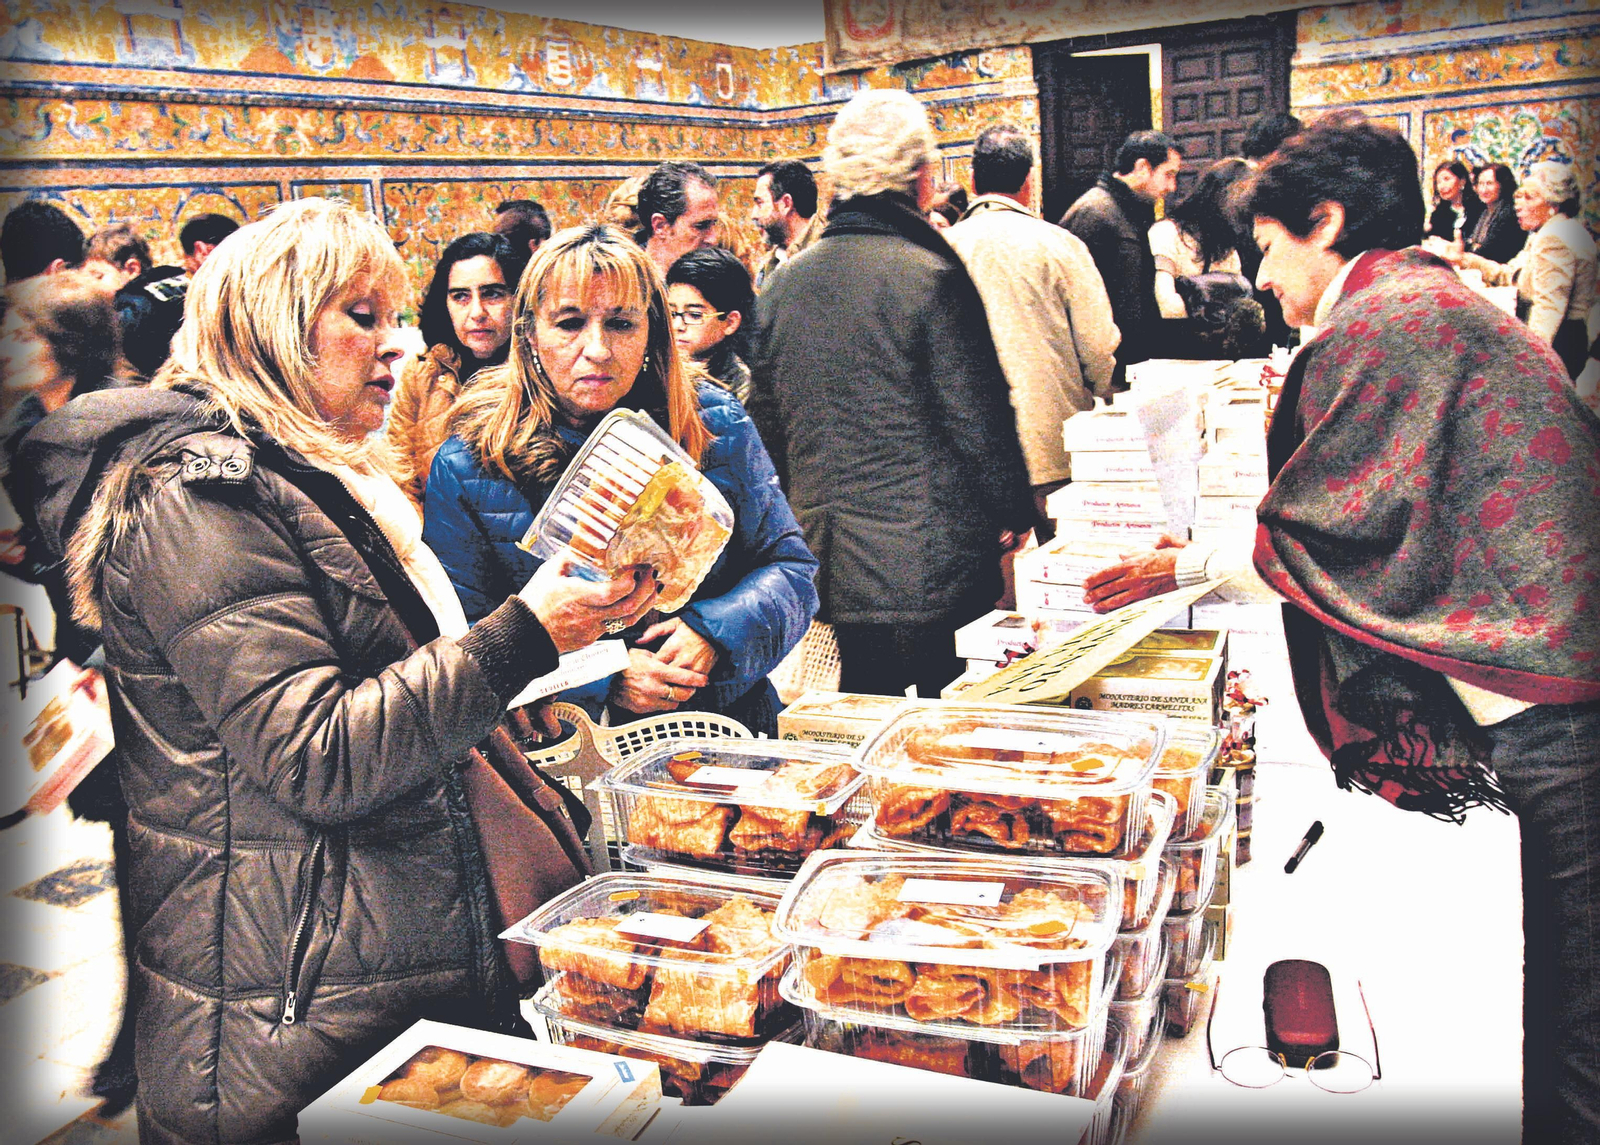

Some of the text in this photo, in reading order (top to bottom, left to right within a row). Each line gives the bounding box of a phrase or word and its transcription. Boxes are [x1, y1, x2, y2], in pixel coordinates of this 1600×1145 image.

[1098, 692, 1208, 705] MONASTERIO DE SANTA ANA
[1110, 701, 1196, 712] MADRES CARMELITAS
[801, 729, 846, 740] MONASTERIO
